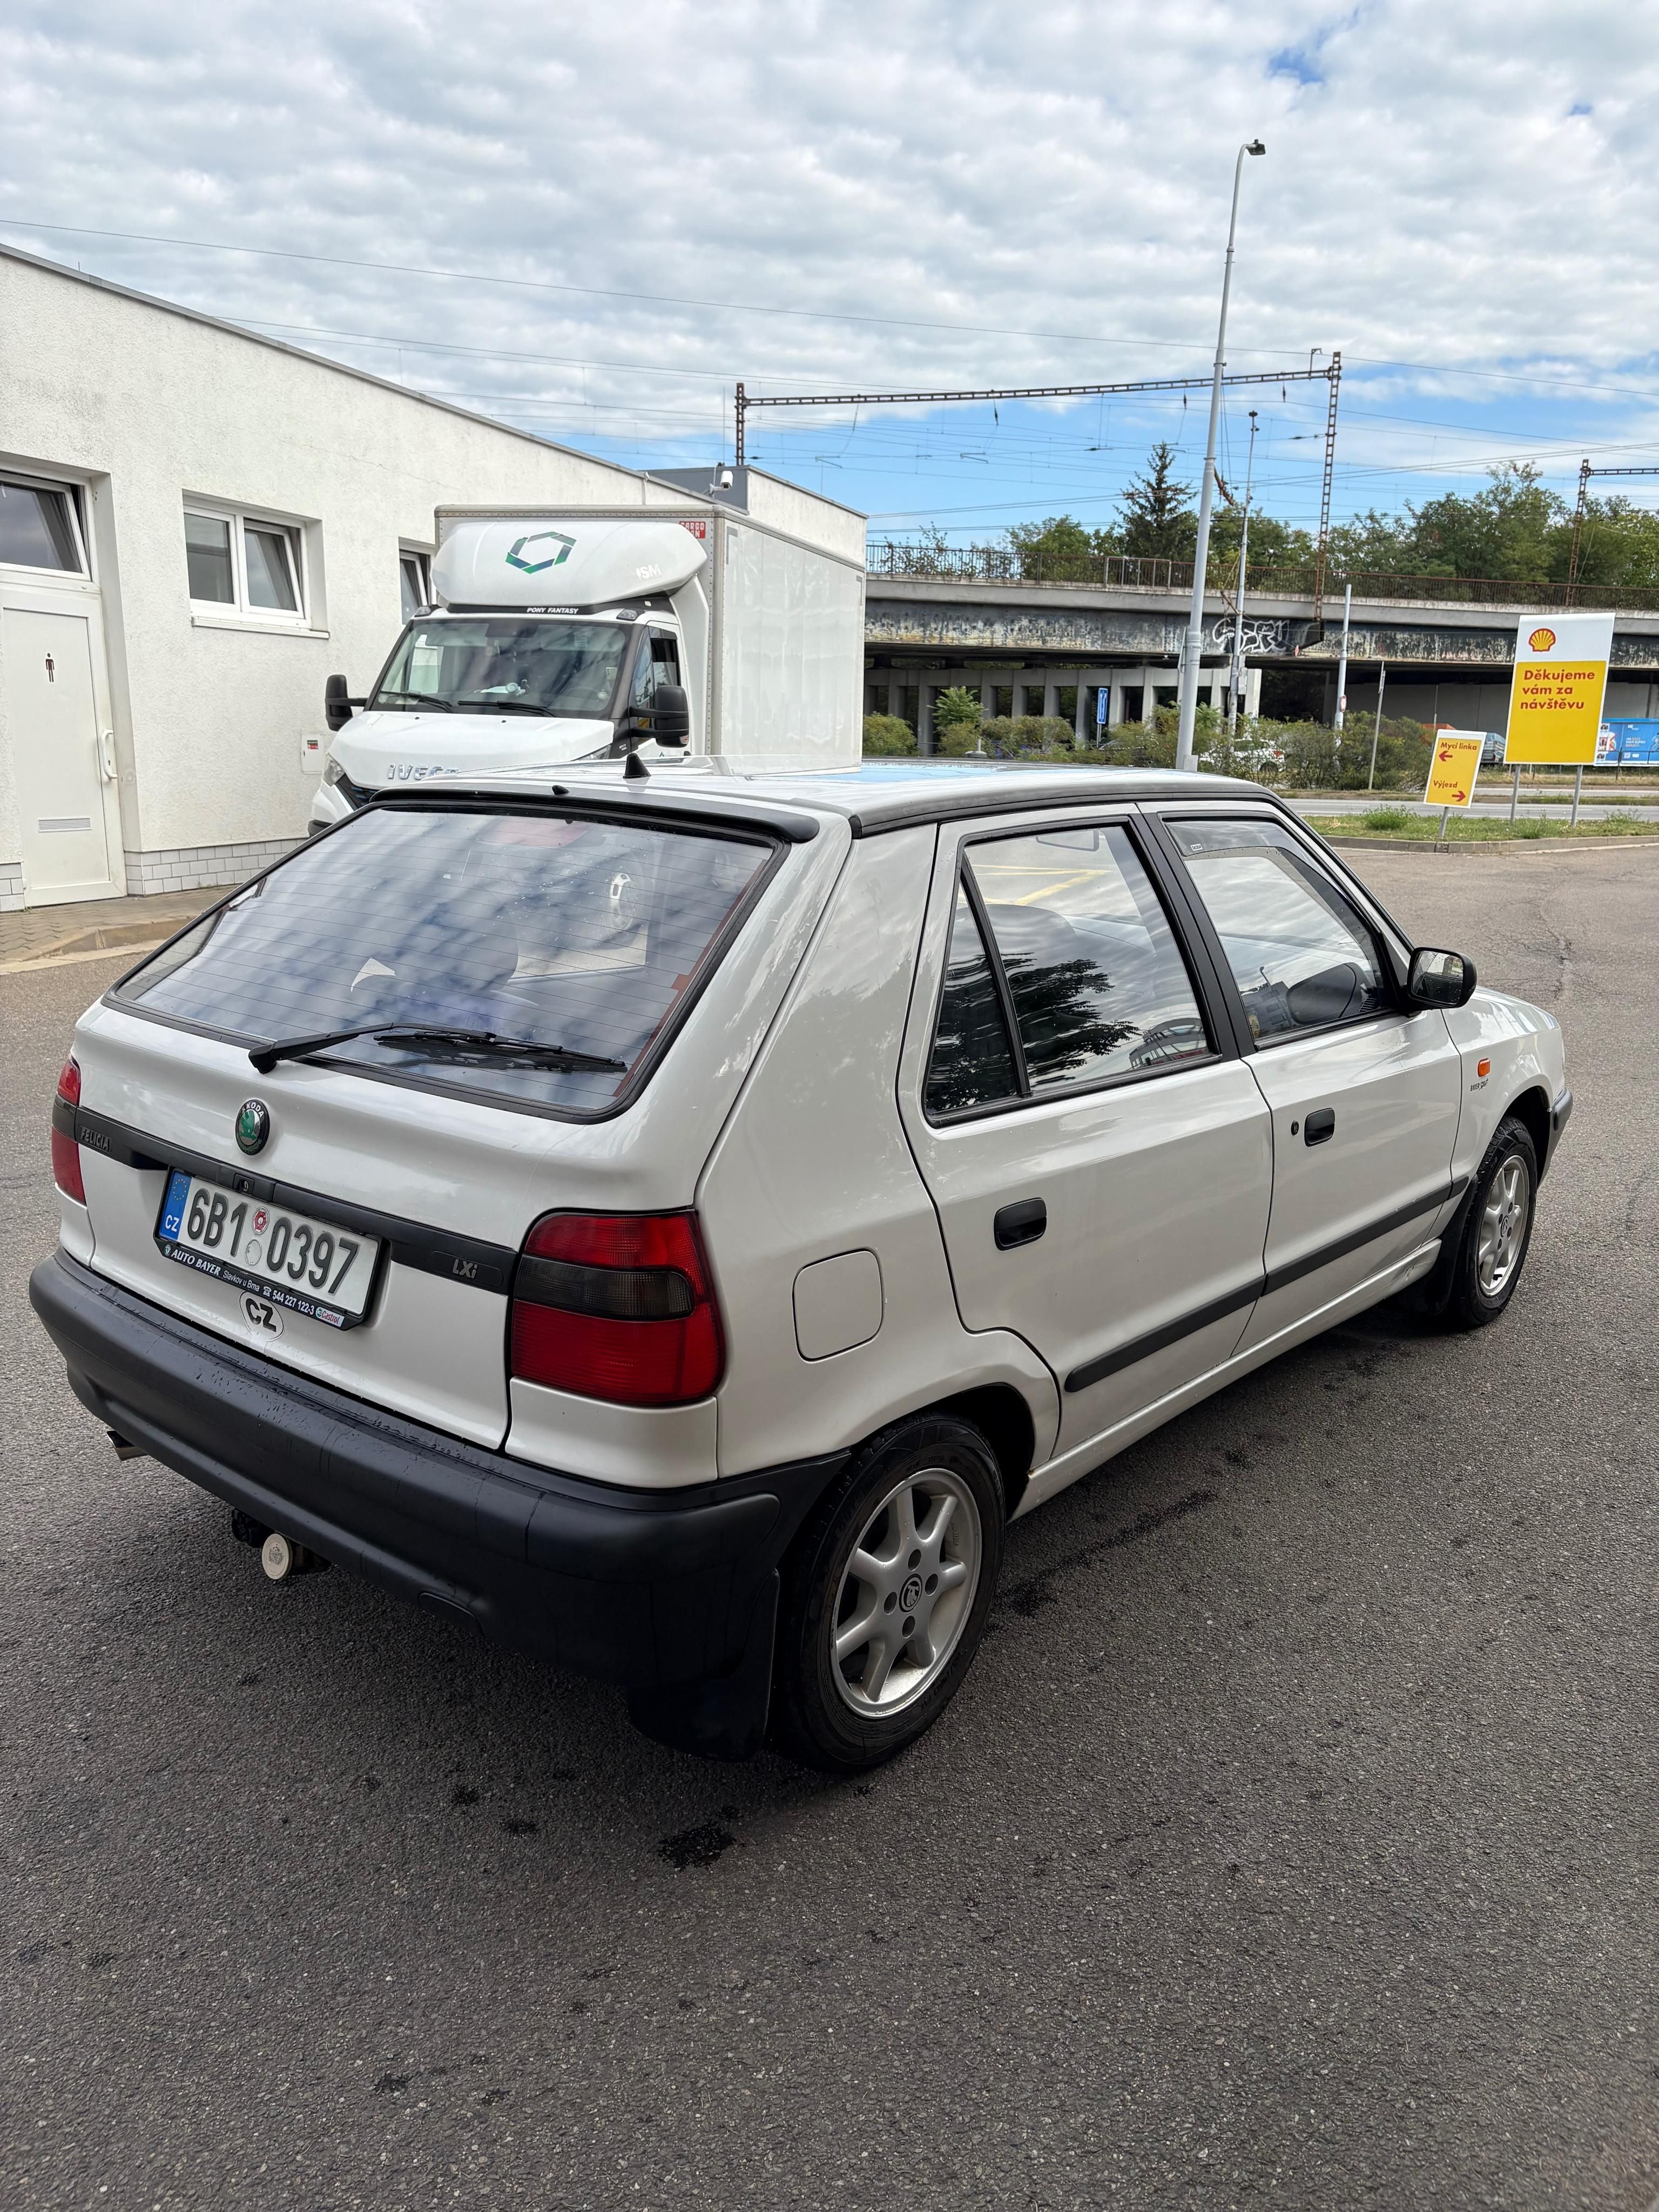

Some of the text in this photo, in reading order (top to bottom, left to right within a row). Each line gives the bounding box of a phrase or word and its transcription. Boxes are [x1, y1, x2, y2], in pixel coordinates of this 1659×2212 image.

[1523, 669, 1595, 683] Děkujeme
[1522, 683, 1573, 695] vám za
[1520, 698, 1584, 710] návštěvu
[1440, 742, 1458, 750] Mycí
[388, 764, 461, 780] IVEC
[1433, 780, 1458, 788] Výjezd
[82, 1127, 109, 1152] FELICIA
[165, 1214, 180, 1232] CZ
[187, 1188, 360, 1295] 6B1 0397
[452, 1258, 478, 1279] LXi
[171, 1249, 195, 1265] AUTO
[195, 1258, 221, 1276] BAYER
[223, 1270, 243, 1285] Slavkov
[247, 1279, 260, 1292] Brna
[272, 1290, 285, 1303] 544
[285, 1295, 297, 1308] 227
[298, 1300, 315, 1316] 122-3
[245, 1298, 277, 1333] CZ
[321, 1310, 341, 1324] Castrol
